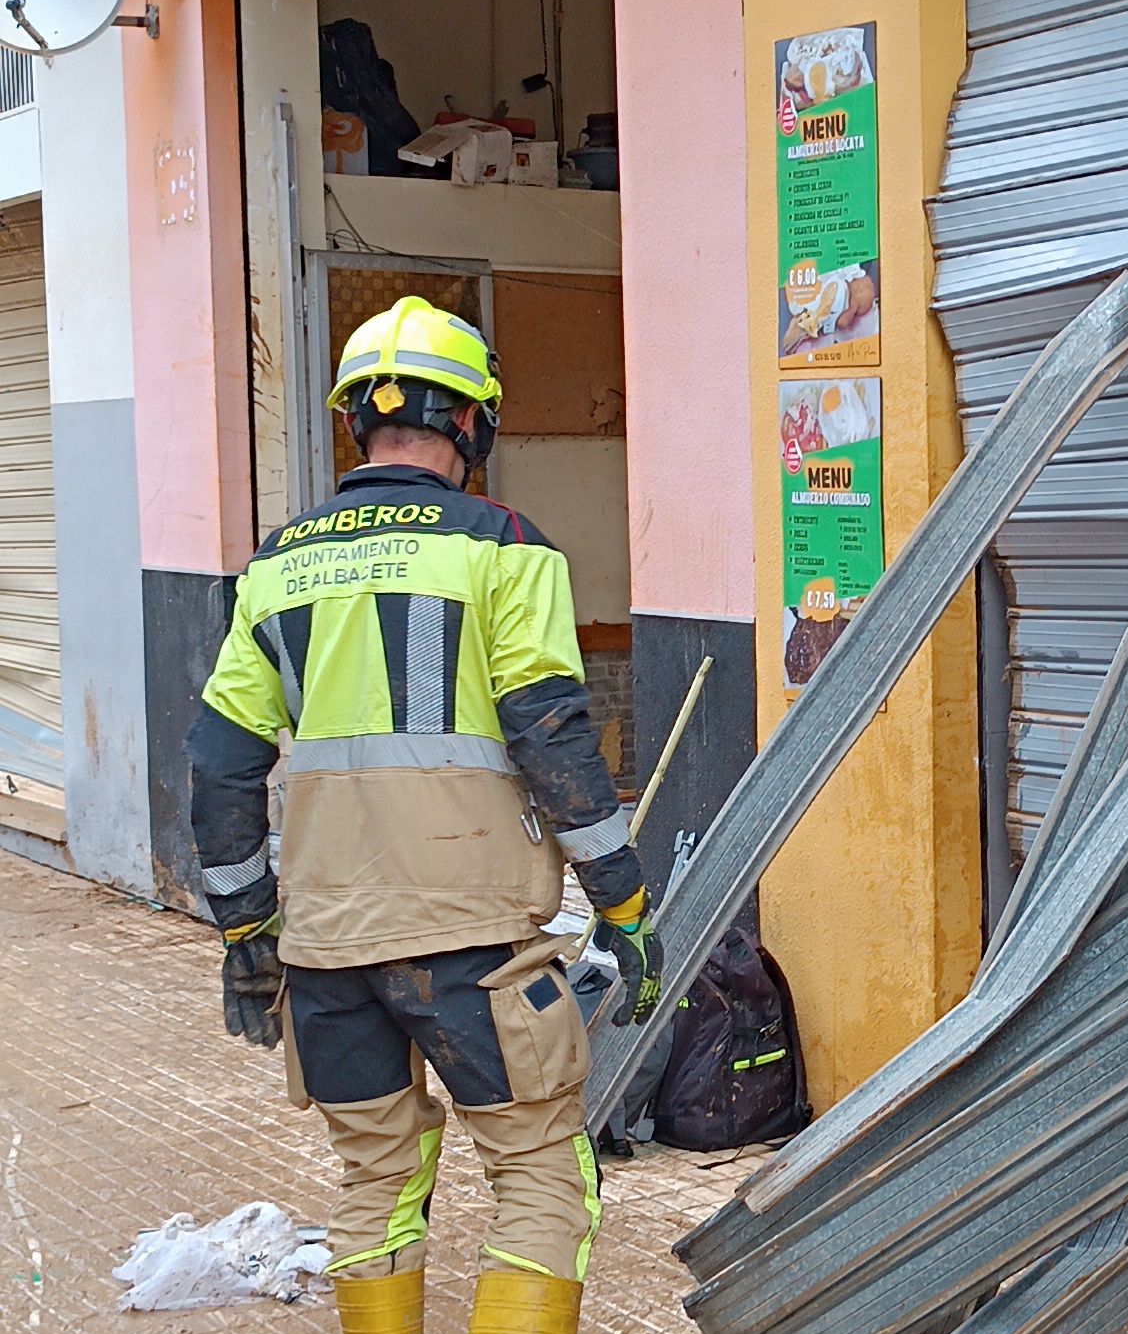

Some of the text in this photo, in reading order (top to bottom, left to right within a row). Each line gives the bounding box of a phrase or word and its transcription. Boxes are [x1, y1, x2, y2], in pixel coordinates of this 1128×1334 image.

[803, 114, 847, 142] MENU
[808, 467, 852, 488] MENU
[276, 504, 443, 547] BOMBEROS
[281, 539, 420, 575] AYUNTAMIENTO
[286, 562, 408, 595] DE ALBACETE
